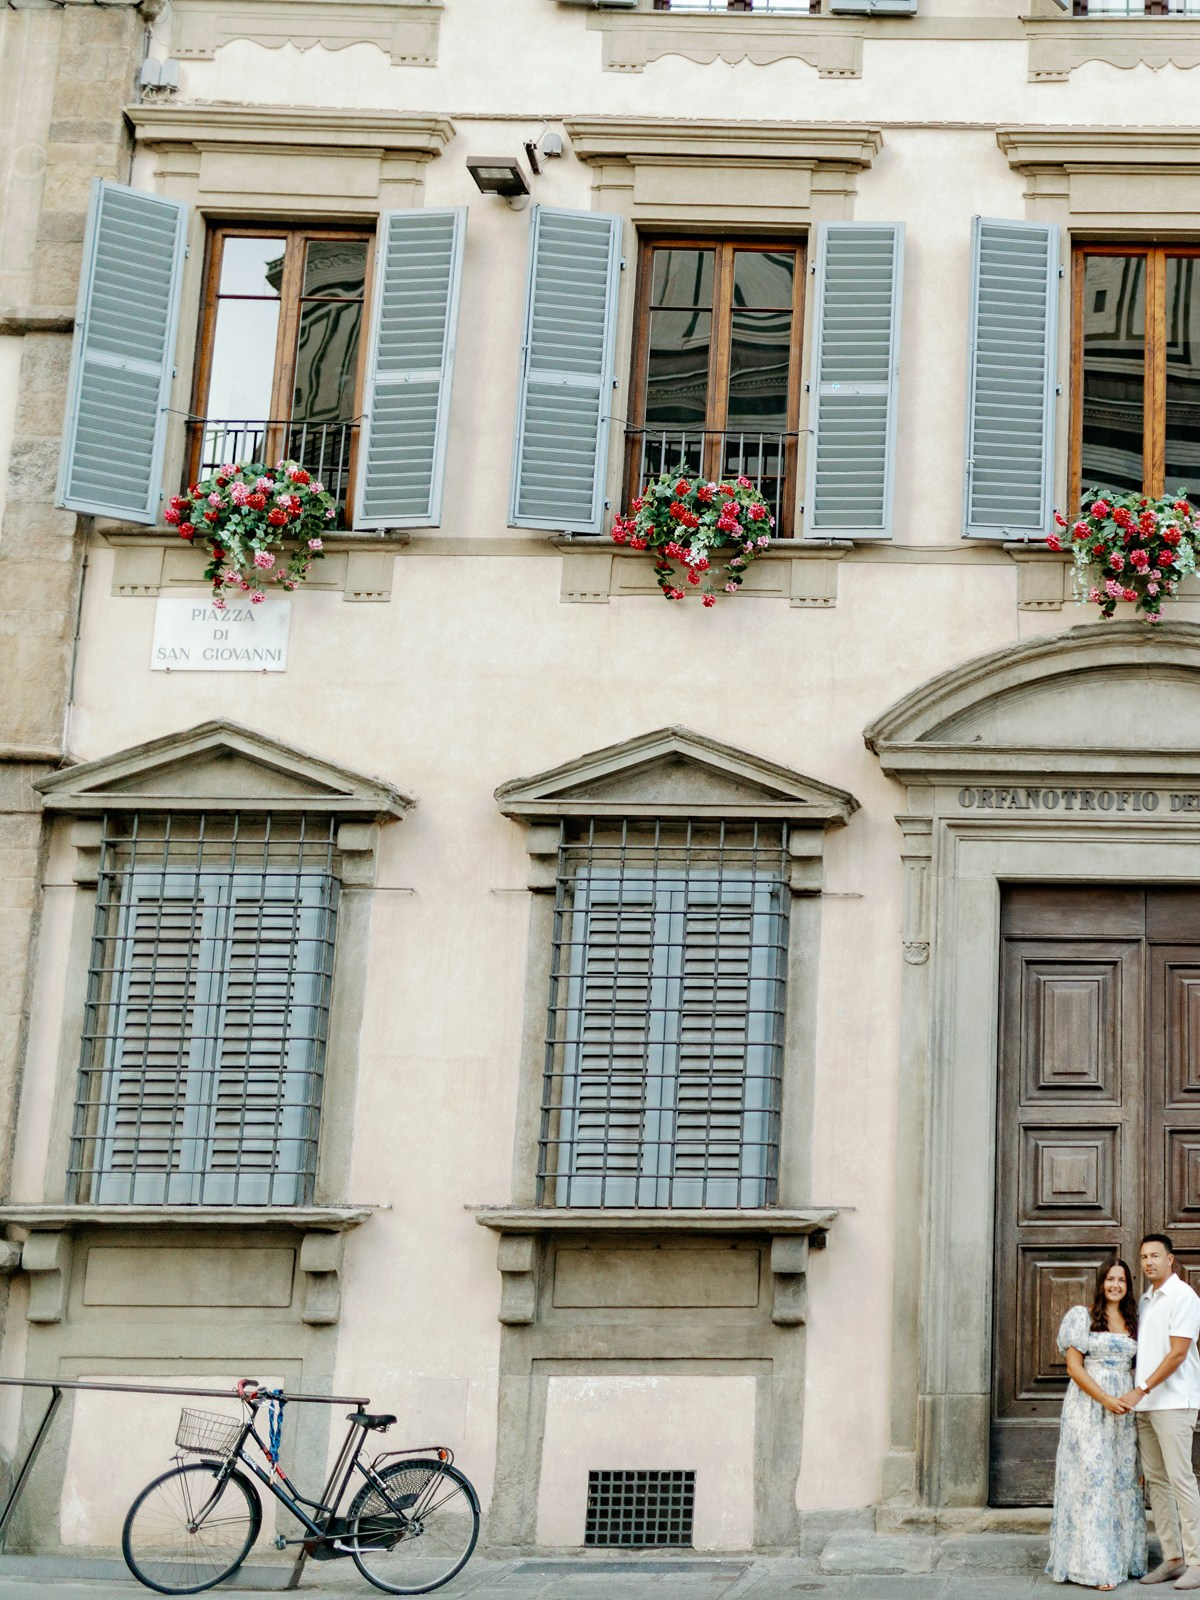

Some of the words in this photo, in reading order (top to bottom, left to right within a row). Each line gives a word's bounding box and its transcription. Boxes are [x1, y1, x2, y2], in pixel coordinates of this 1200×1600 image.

[191, 608, 255, 622] PIAZZA
[213, 629, 229, 641] DI
[156, 647, 190, 661] SAN
[202, 648, 282, 662] GIOVANNI
[958, 786, 1160, 812] ORFANOTROFIO
